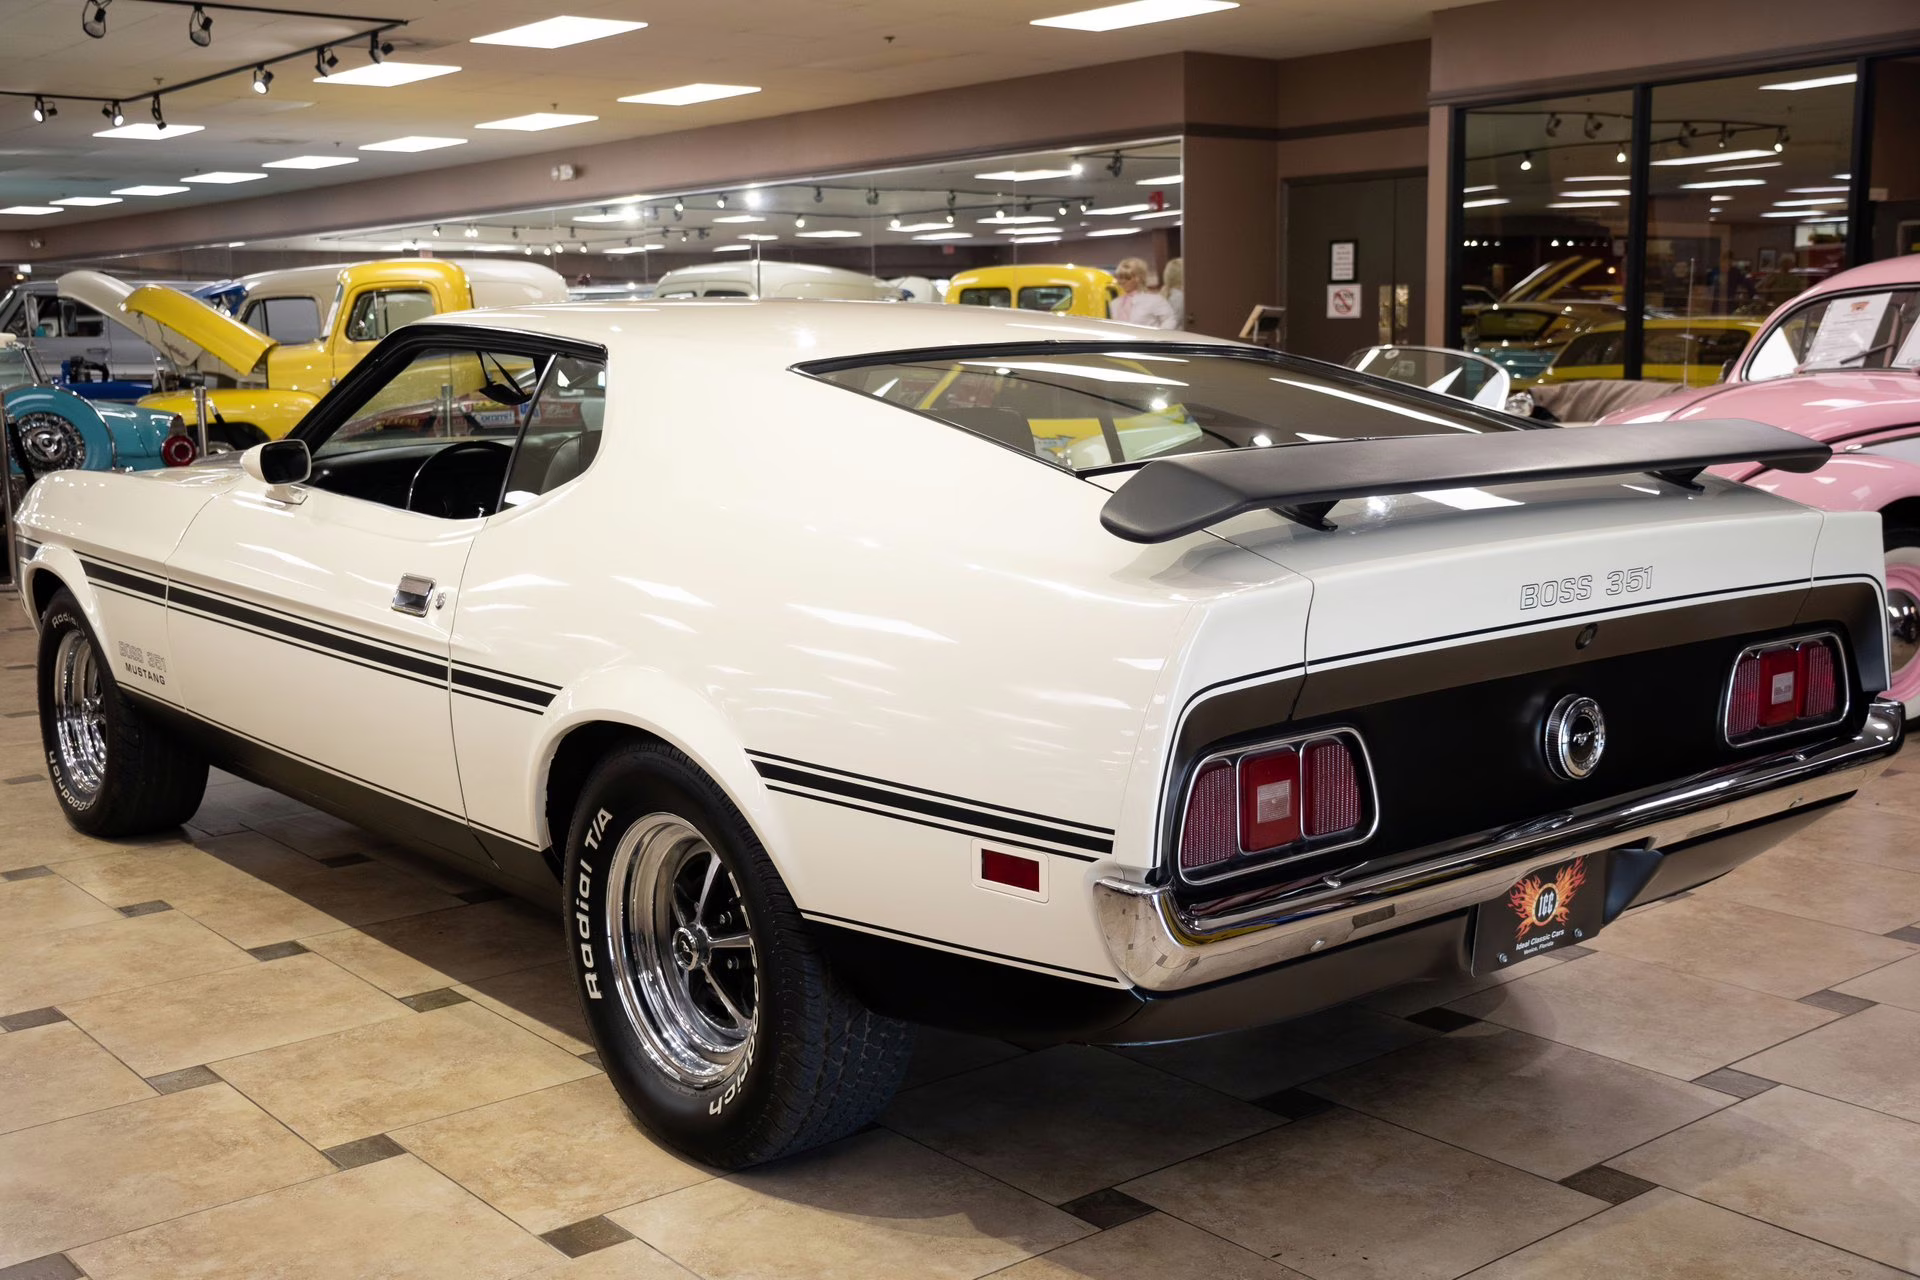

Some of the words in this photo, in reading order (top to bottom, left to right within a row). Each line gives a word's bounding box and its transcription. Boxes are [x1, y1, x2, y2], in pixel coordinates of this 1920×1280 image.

[1520, 575, 1593, 610] BOSS
[1605, 565, 1654, 596] 351
[125, 662, 166, 685] MUSTANG
[584, 807, 613, 850] T/A
[576, 858, 602, 999] Radial
[1516, 940, 1530, 951] Ideal
[1531, 934, 1550, 945] Classic
[1552, 929, 1565, 938] Cars
